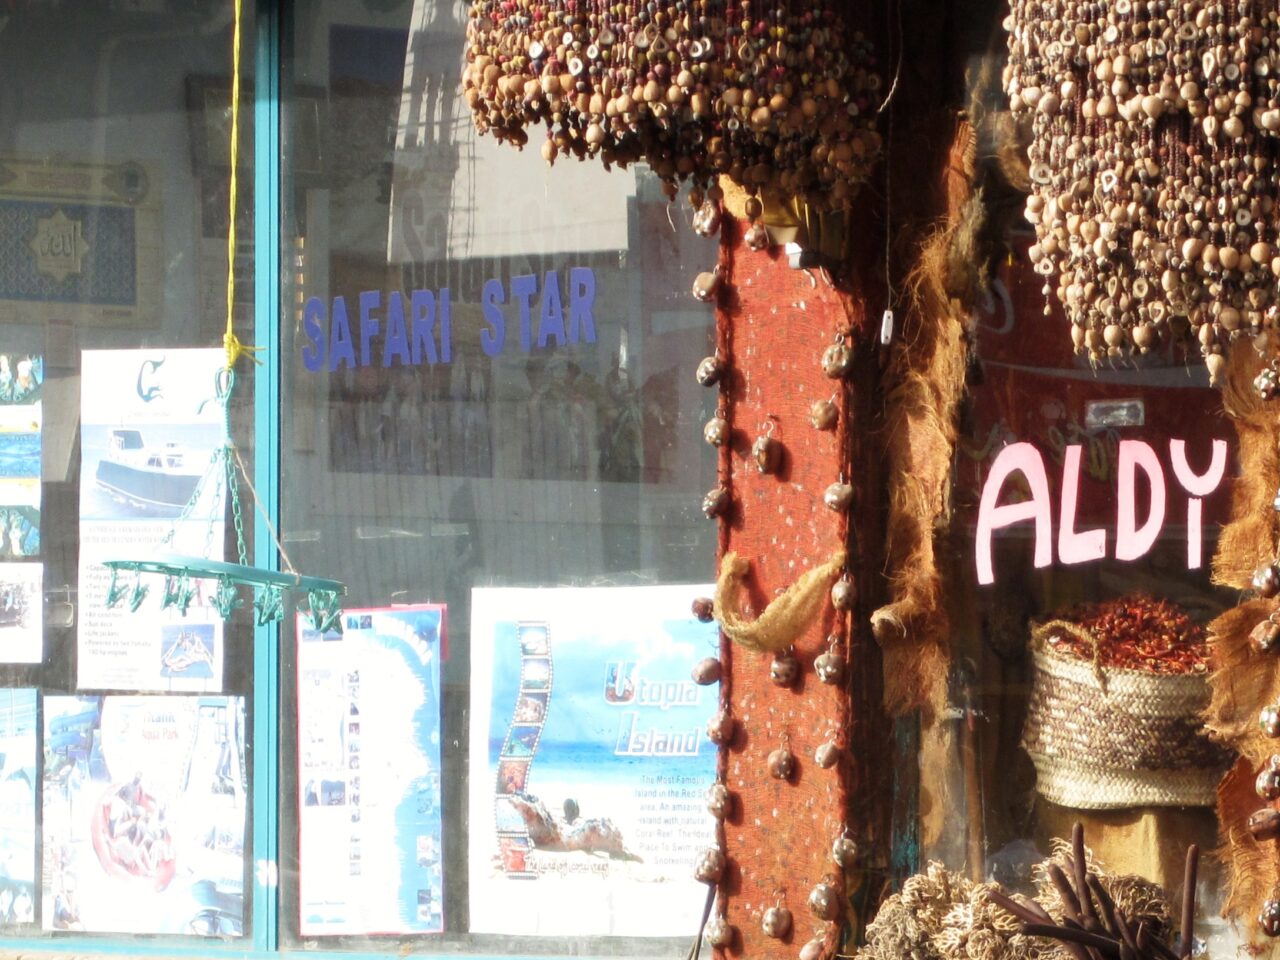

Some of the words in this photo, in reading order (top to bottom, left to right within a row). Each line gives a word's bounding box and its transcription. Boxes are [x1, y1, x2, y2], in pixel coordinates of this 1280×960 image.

[302, 288, 452, 373] SAFARI
[480, 267, 598, 358] STAR
[975, 438, 1228, 586] ALDY
[601, 660, 702, 710] Utopia
[614, 710, 702, 757] Island
